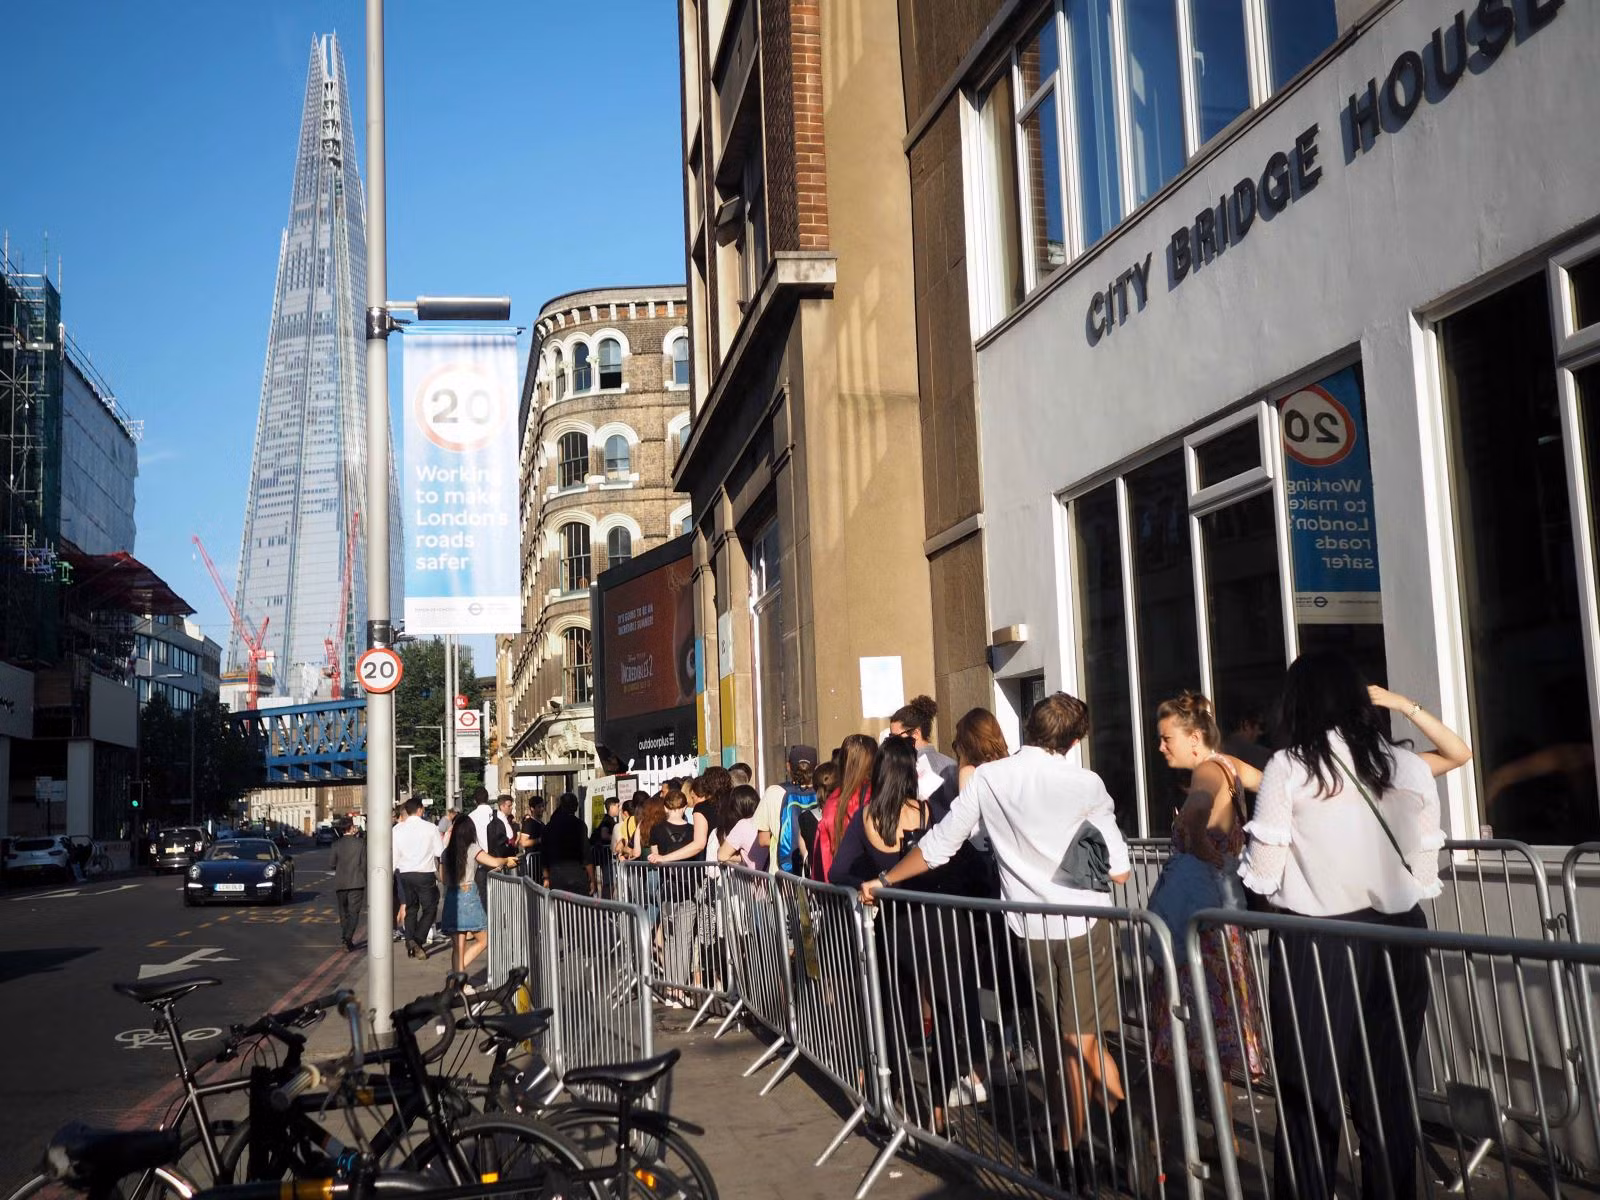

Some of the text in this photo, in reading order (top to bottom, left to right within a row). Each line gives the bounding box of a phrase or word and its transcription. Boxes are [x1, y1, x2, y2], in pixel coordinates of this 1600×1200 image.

[1089, 251, 1153, 338] CITY
[1171, 122, 1323, 283] BRIDGE
[431, 388, 493, 425] 20
[416, 465, 500, 486] Workin
[415, 488, 439, 504] to
[415, 531, 475, 549] roads
[415, 552, 470, 570] safer
[363, 661, 395, 680] 20
[638, 735, 670, 751] outdoorplus
